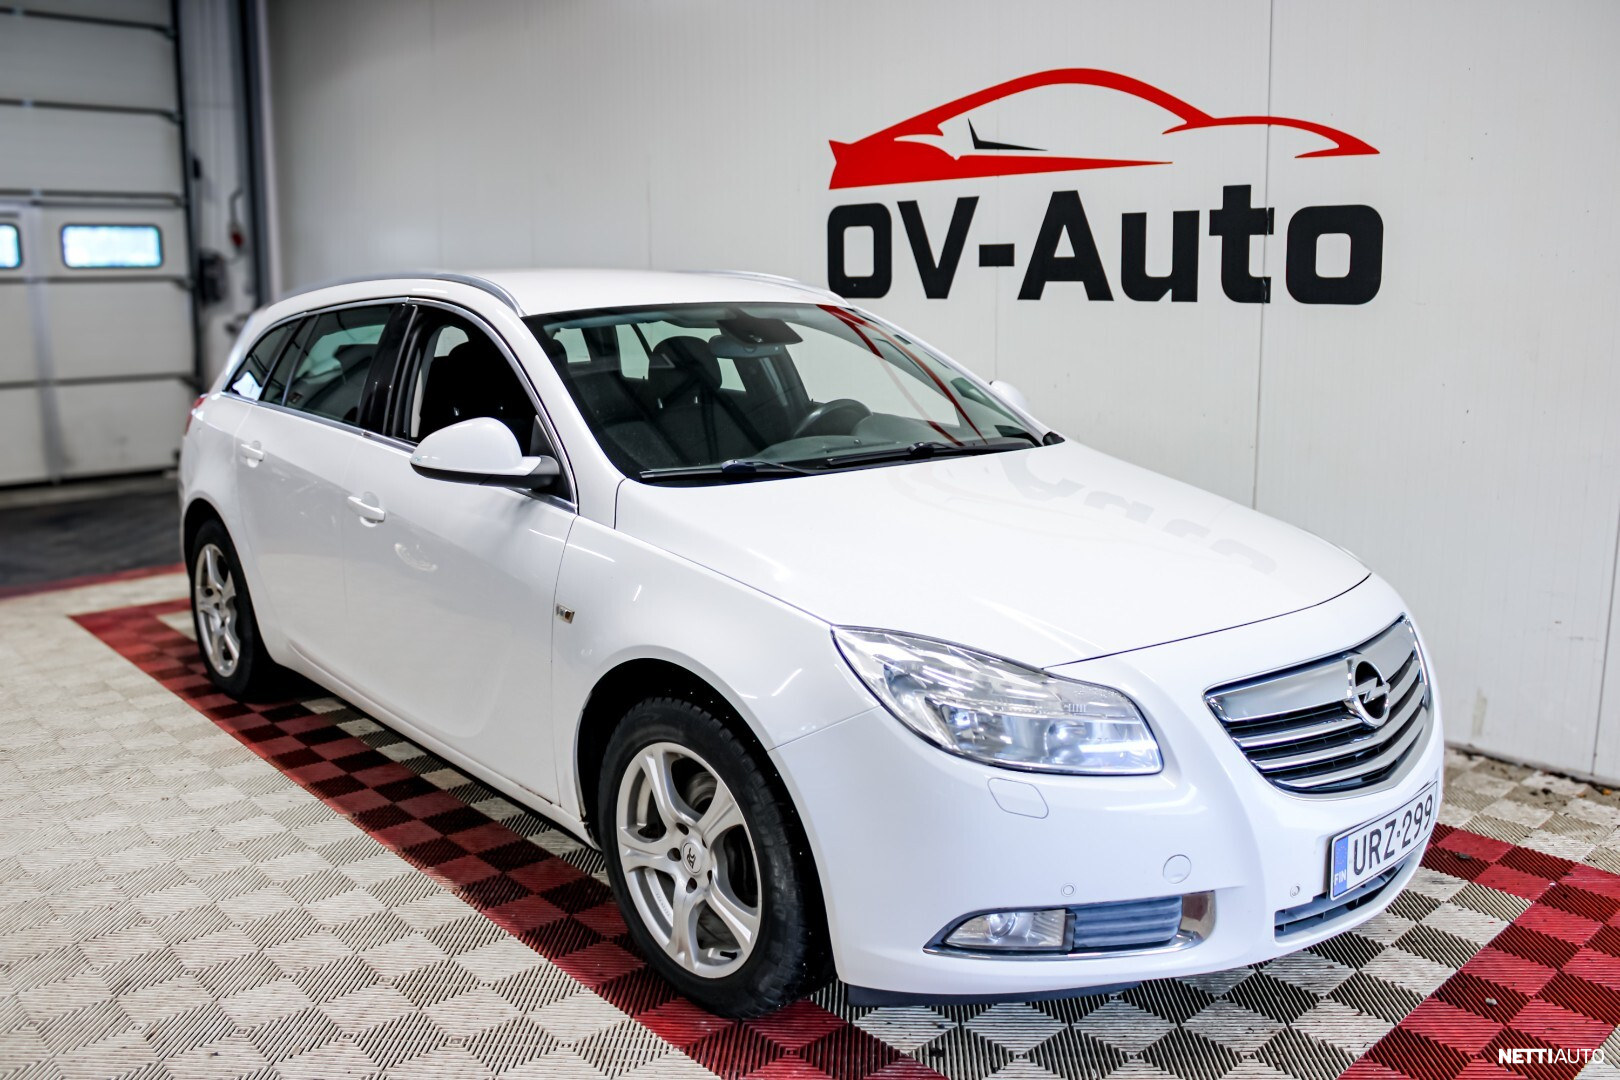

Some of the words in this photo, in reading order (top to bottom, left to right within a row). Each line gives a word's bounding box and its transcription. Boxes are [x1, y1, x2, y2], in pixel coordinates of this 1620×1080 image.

[827, 184, 1384, 305] OV-Auto
[1353, 794, 1433, 876] URZ-299
[1333, 869, 1347, 886] FIN
